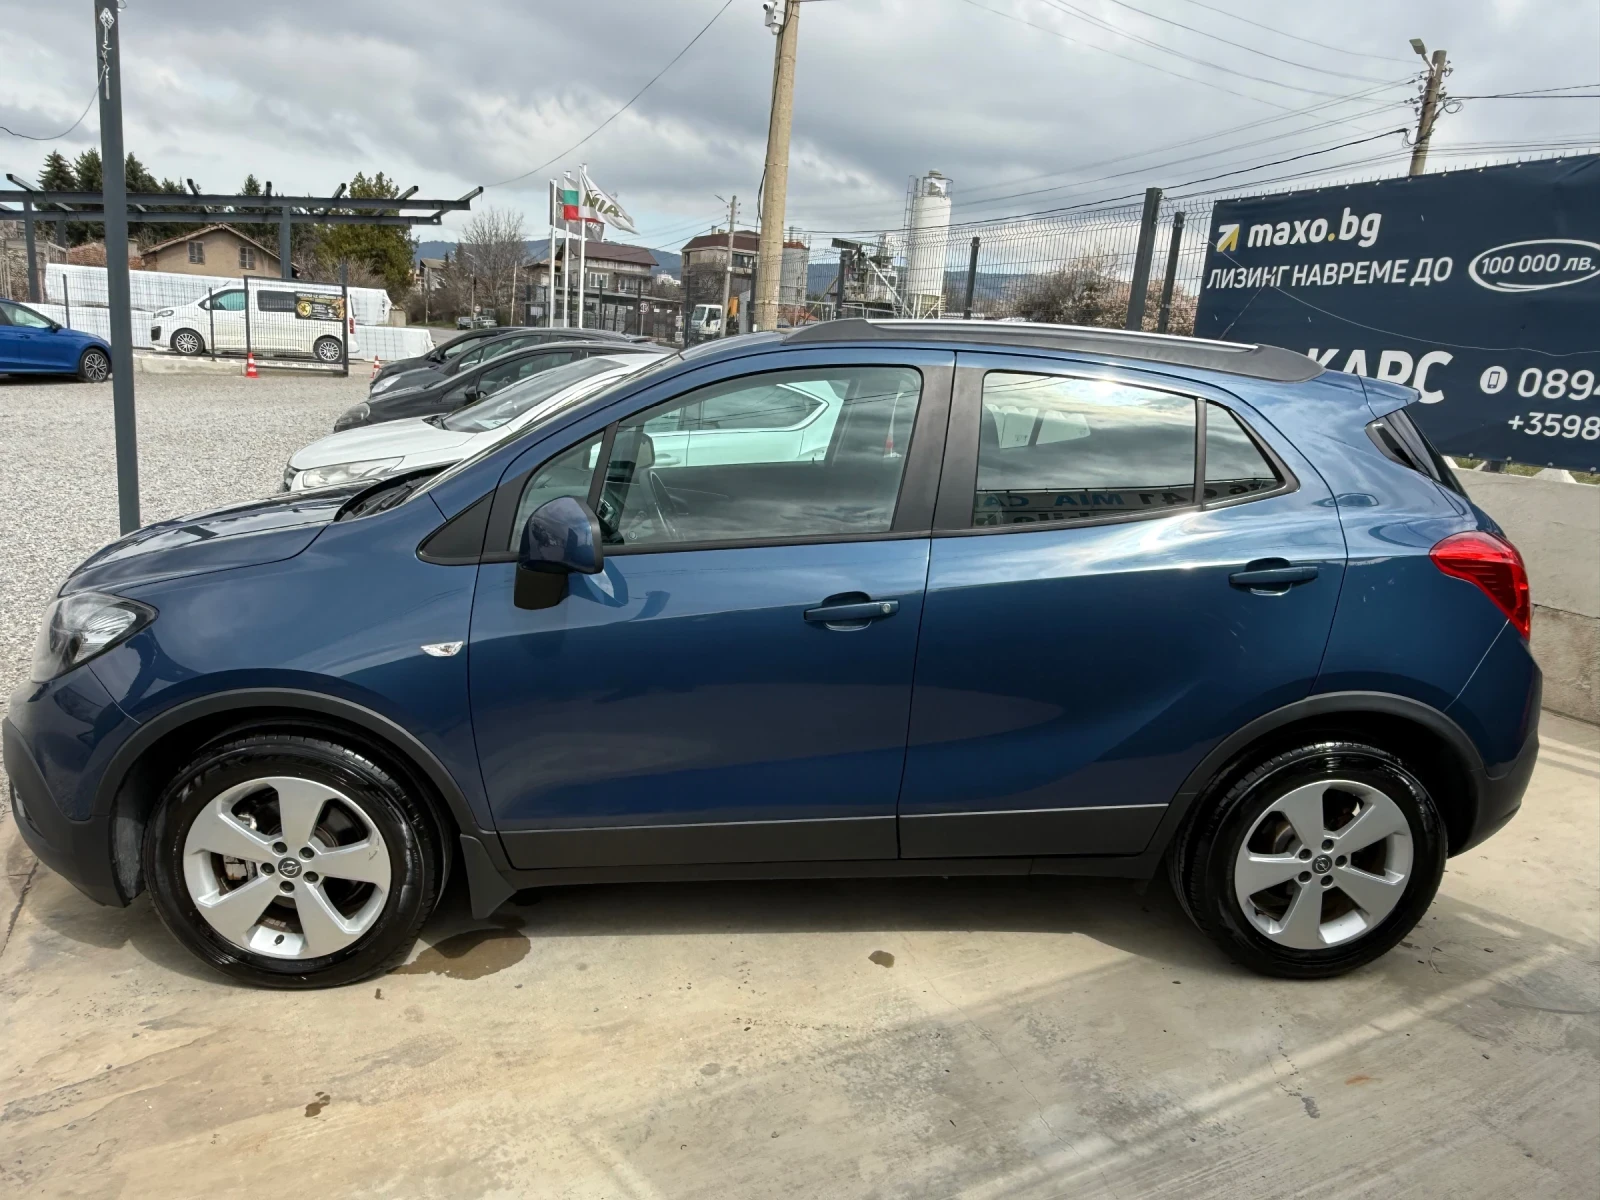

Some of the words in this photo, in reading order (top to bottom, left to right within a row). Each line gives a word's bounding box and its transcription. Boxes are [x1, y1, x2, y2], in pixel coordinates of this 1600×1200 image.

[582, 191, 620, 217] MIA
[1247, 207, 1382, 248] maxo.bg
[1206, 265, 1290, 289] ЛИЗИНГ
[1291, 259, 1409, 287] НАВРЕМЕ
[1409, 256, 1453, 287] ДО
[1481, 256, 1515, 275] 100
[1518, 253, 1561, 273] 000
[1562, 256, 1597, 272] лв.
[1517, 367, 1600, 401] 089
[1508, 412, 1600, 441] +3598
